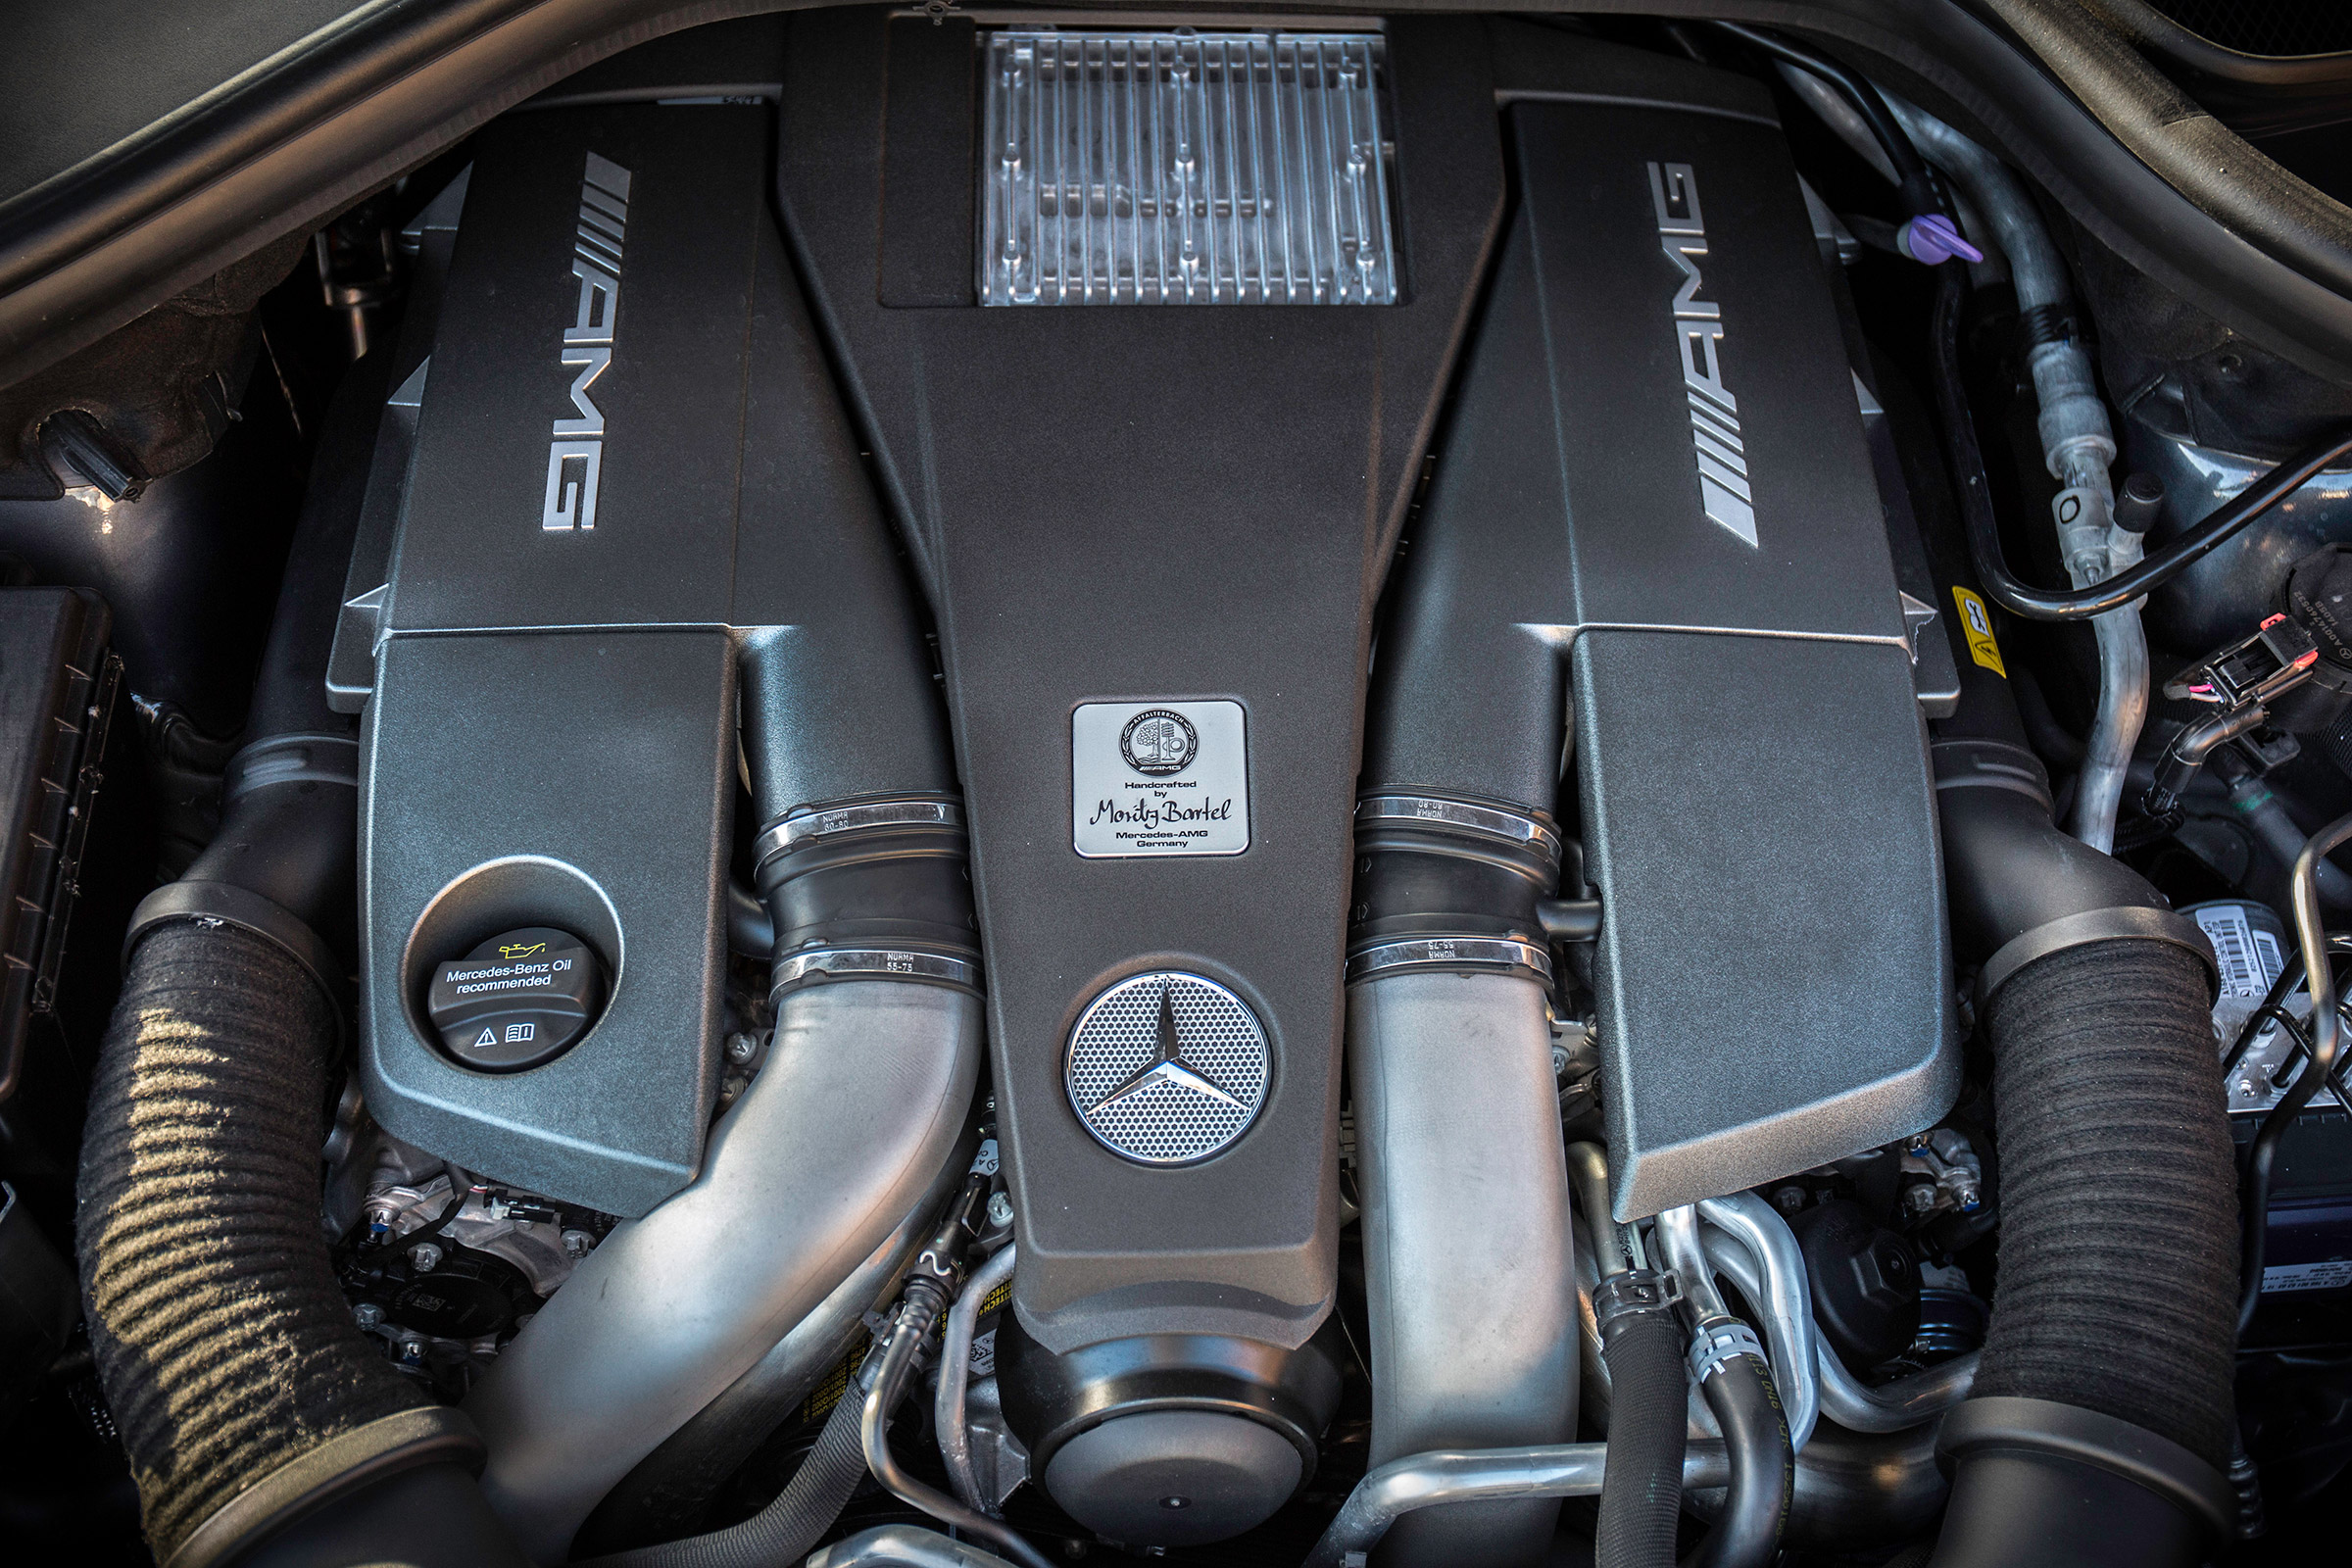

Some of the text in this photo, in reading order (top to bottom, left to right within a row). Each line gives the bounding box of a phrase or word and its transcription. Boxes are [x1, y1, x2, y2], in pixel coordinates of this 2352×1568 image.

[1646, 161, 1738, 414] AMG
[542, 261, 621, 531] AMG
[1133, 710, 1185, 724] AFFALTERBACH
[1124, 780, 1197, 789] Handcrafted
[1161, 796, 1232, 822] Bartel
[1115, 829, 1208, 839] Mercedes-AMG
[446, 959, 571, 983] Mercedes-Benz Oil
[886, 961, 913, 972] 55-75
[456, 974, 552, 995] recommended
